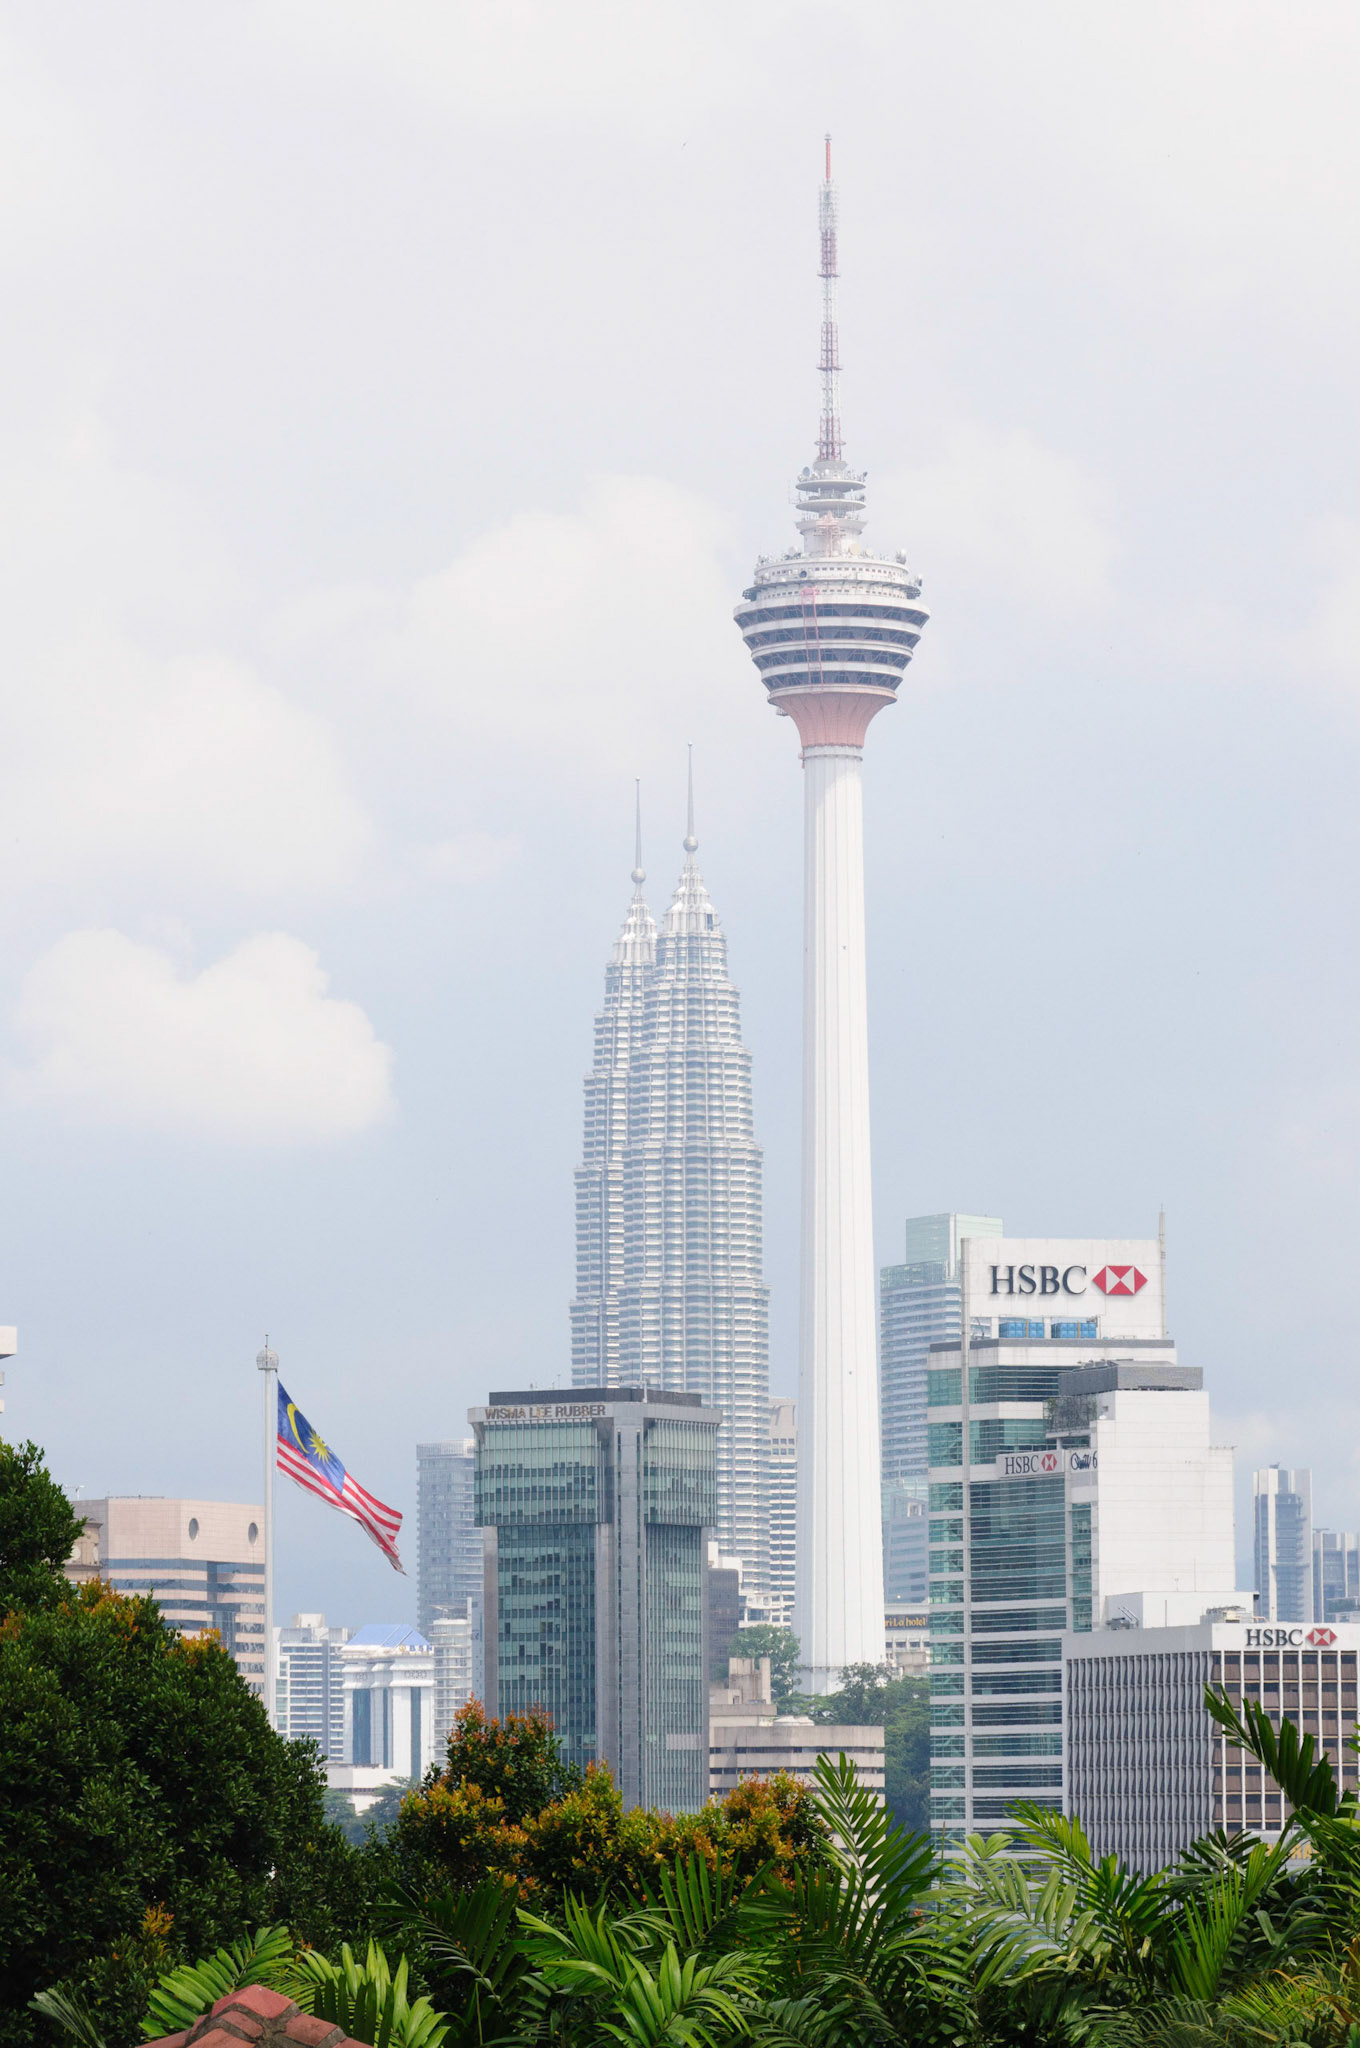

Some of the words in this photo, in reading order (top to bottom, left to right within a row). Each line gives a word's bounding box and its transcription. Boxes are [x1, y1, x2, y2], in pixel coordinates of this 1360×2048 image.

[989, 1265, 1087, 1295] HSBC
[485, 1407, 526, 1419] WISMA
[529, 1406, 553, 1418] LEE
[555, 1404, 606, 1417] RUBBER
[1005, 1455, 1040, 1475] HSBC
[1246, 1628, 1303, 1647] HSBC
